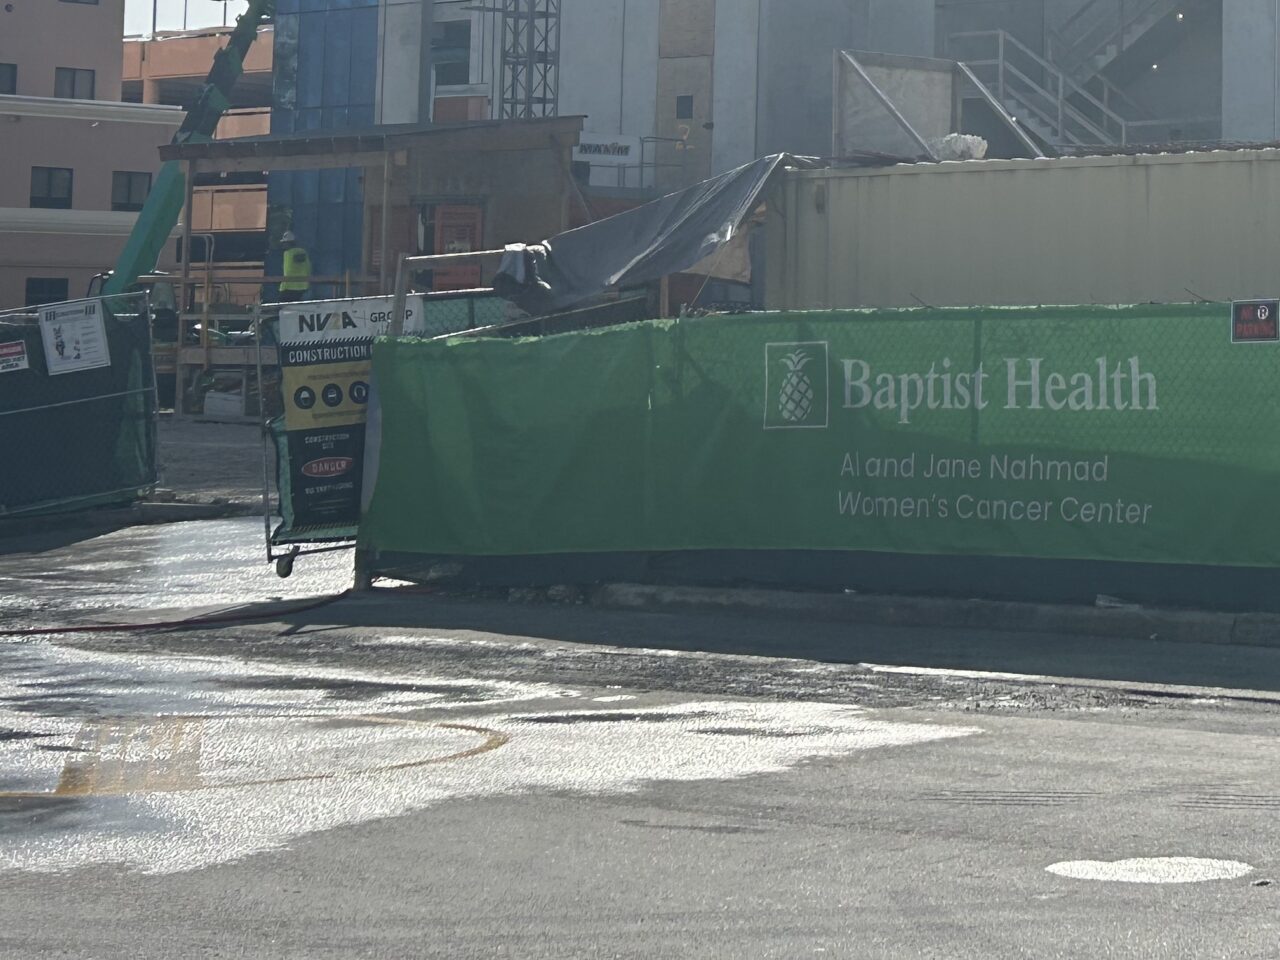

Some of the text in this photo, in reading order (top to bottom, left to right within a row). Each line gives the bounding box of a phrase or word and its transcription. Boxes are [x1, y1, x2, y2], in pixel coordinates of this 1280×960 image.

[289, 344, 367, 364] CONSTRUCTION
[841, 355, 1160, 425] Baptist Health
[840, 452, 1109, 482] Al and Jane Nahmad
[838, 490, 1153, 525] Women's Cancer Center
